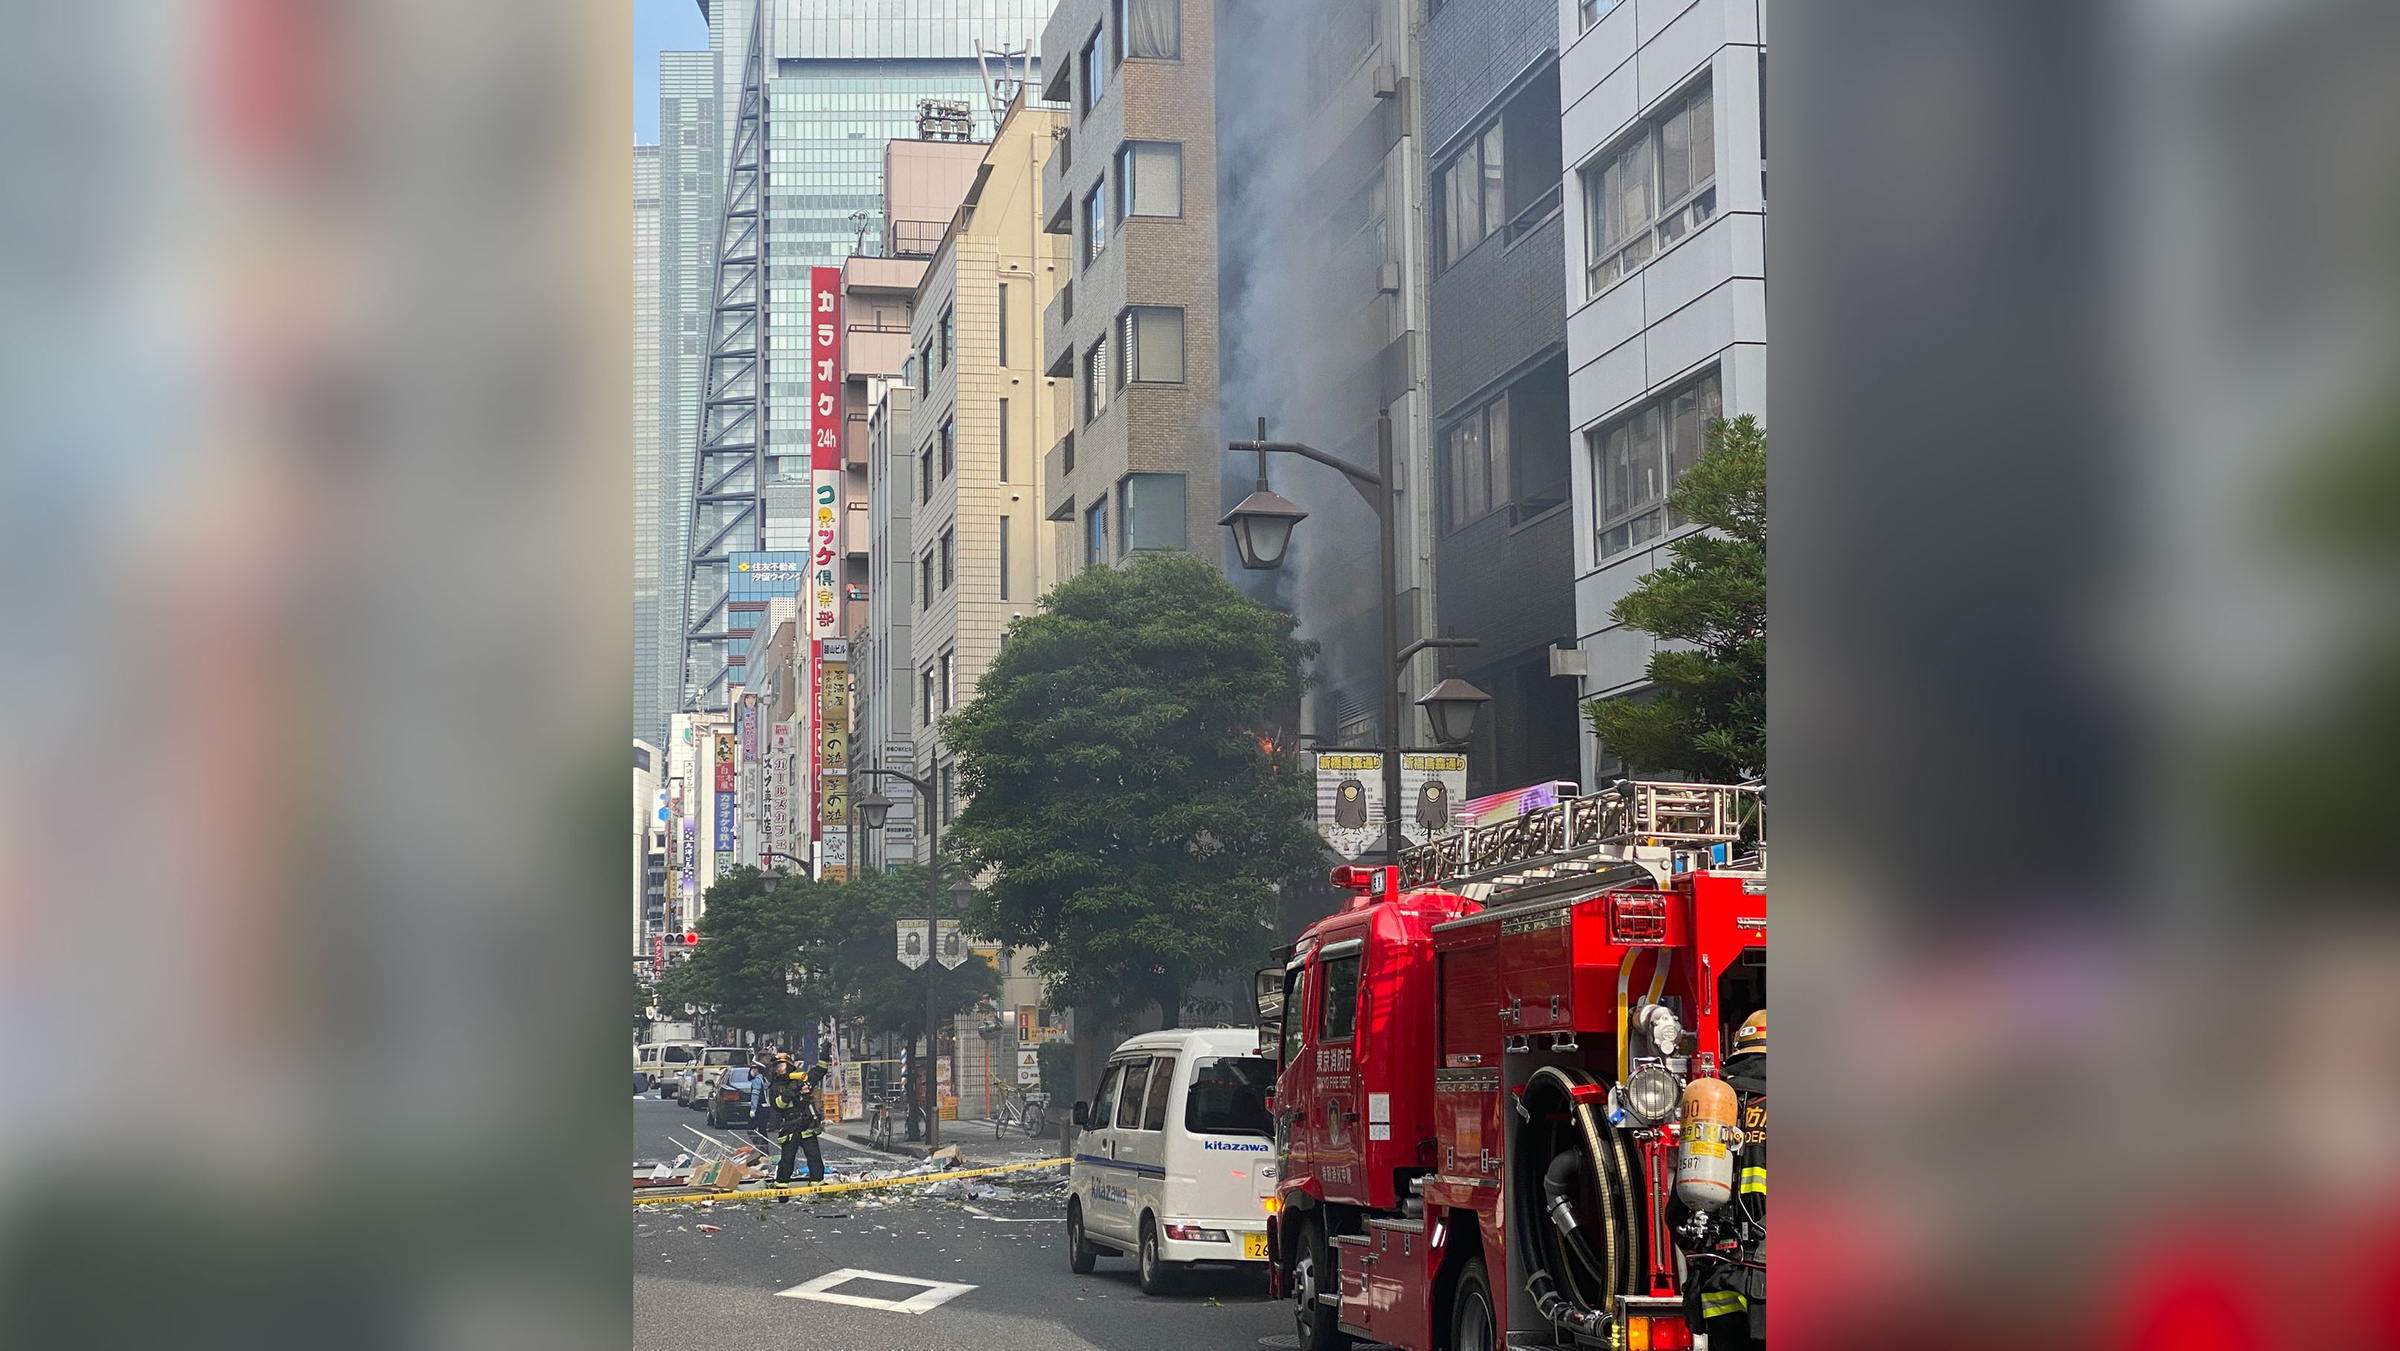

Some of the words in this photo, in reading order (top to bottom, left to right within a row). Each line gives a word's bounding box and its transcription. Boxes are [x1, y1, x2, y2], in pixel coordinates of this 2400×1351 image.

[817, 289, 835, 417] カラオケ
[817, 428, 836, 448] 24h
[752, 562, 797, 571] 住友不動産
[833, 670, 845, 706] 居酒屋
[719, 794, 730, 849] カラオケの鉄人
[684, 842, 694, 867] 大洋ビル
[824, 852, 846, 860] 一心
[1316, 1047, 1352, 1072] 東京消防庁
[1330, 1076, 1339, 1089] FIRE
[1204, 1140, 1269, 1152] kitazawa
[1091, 1175, 1128, 1205] kitazawa
